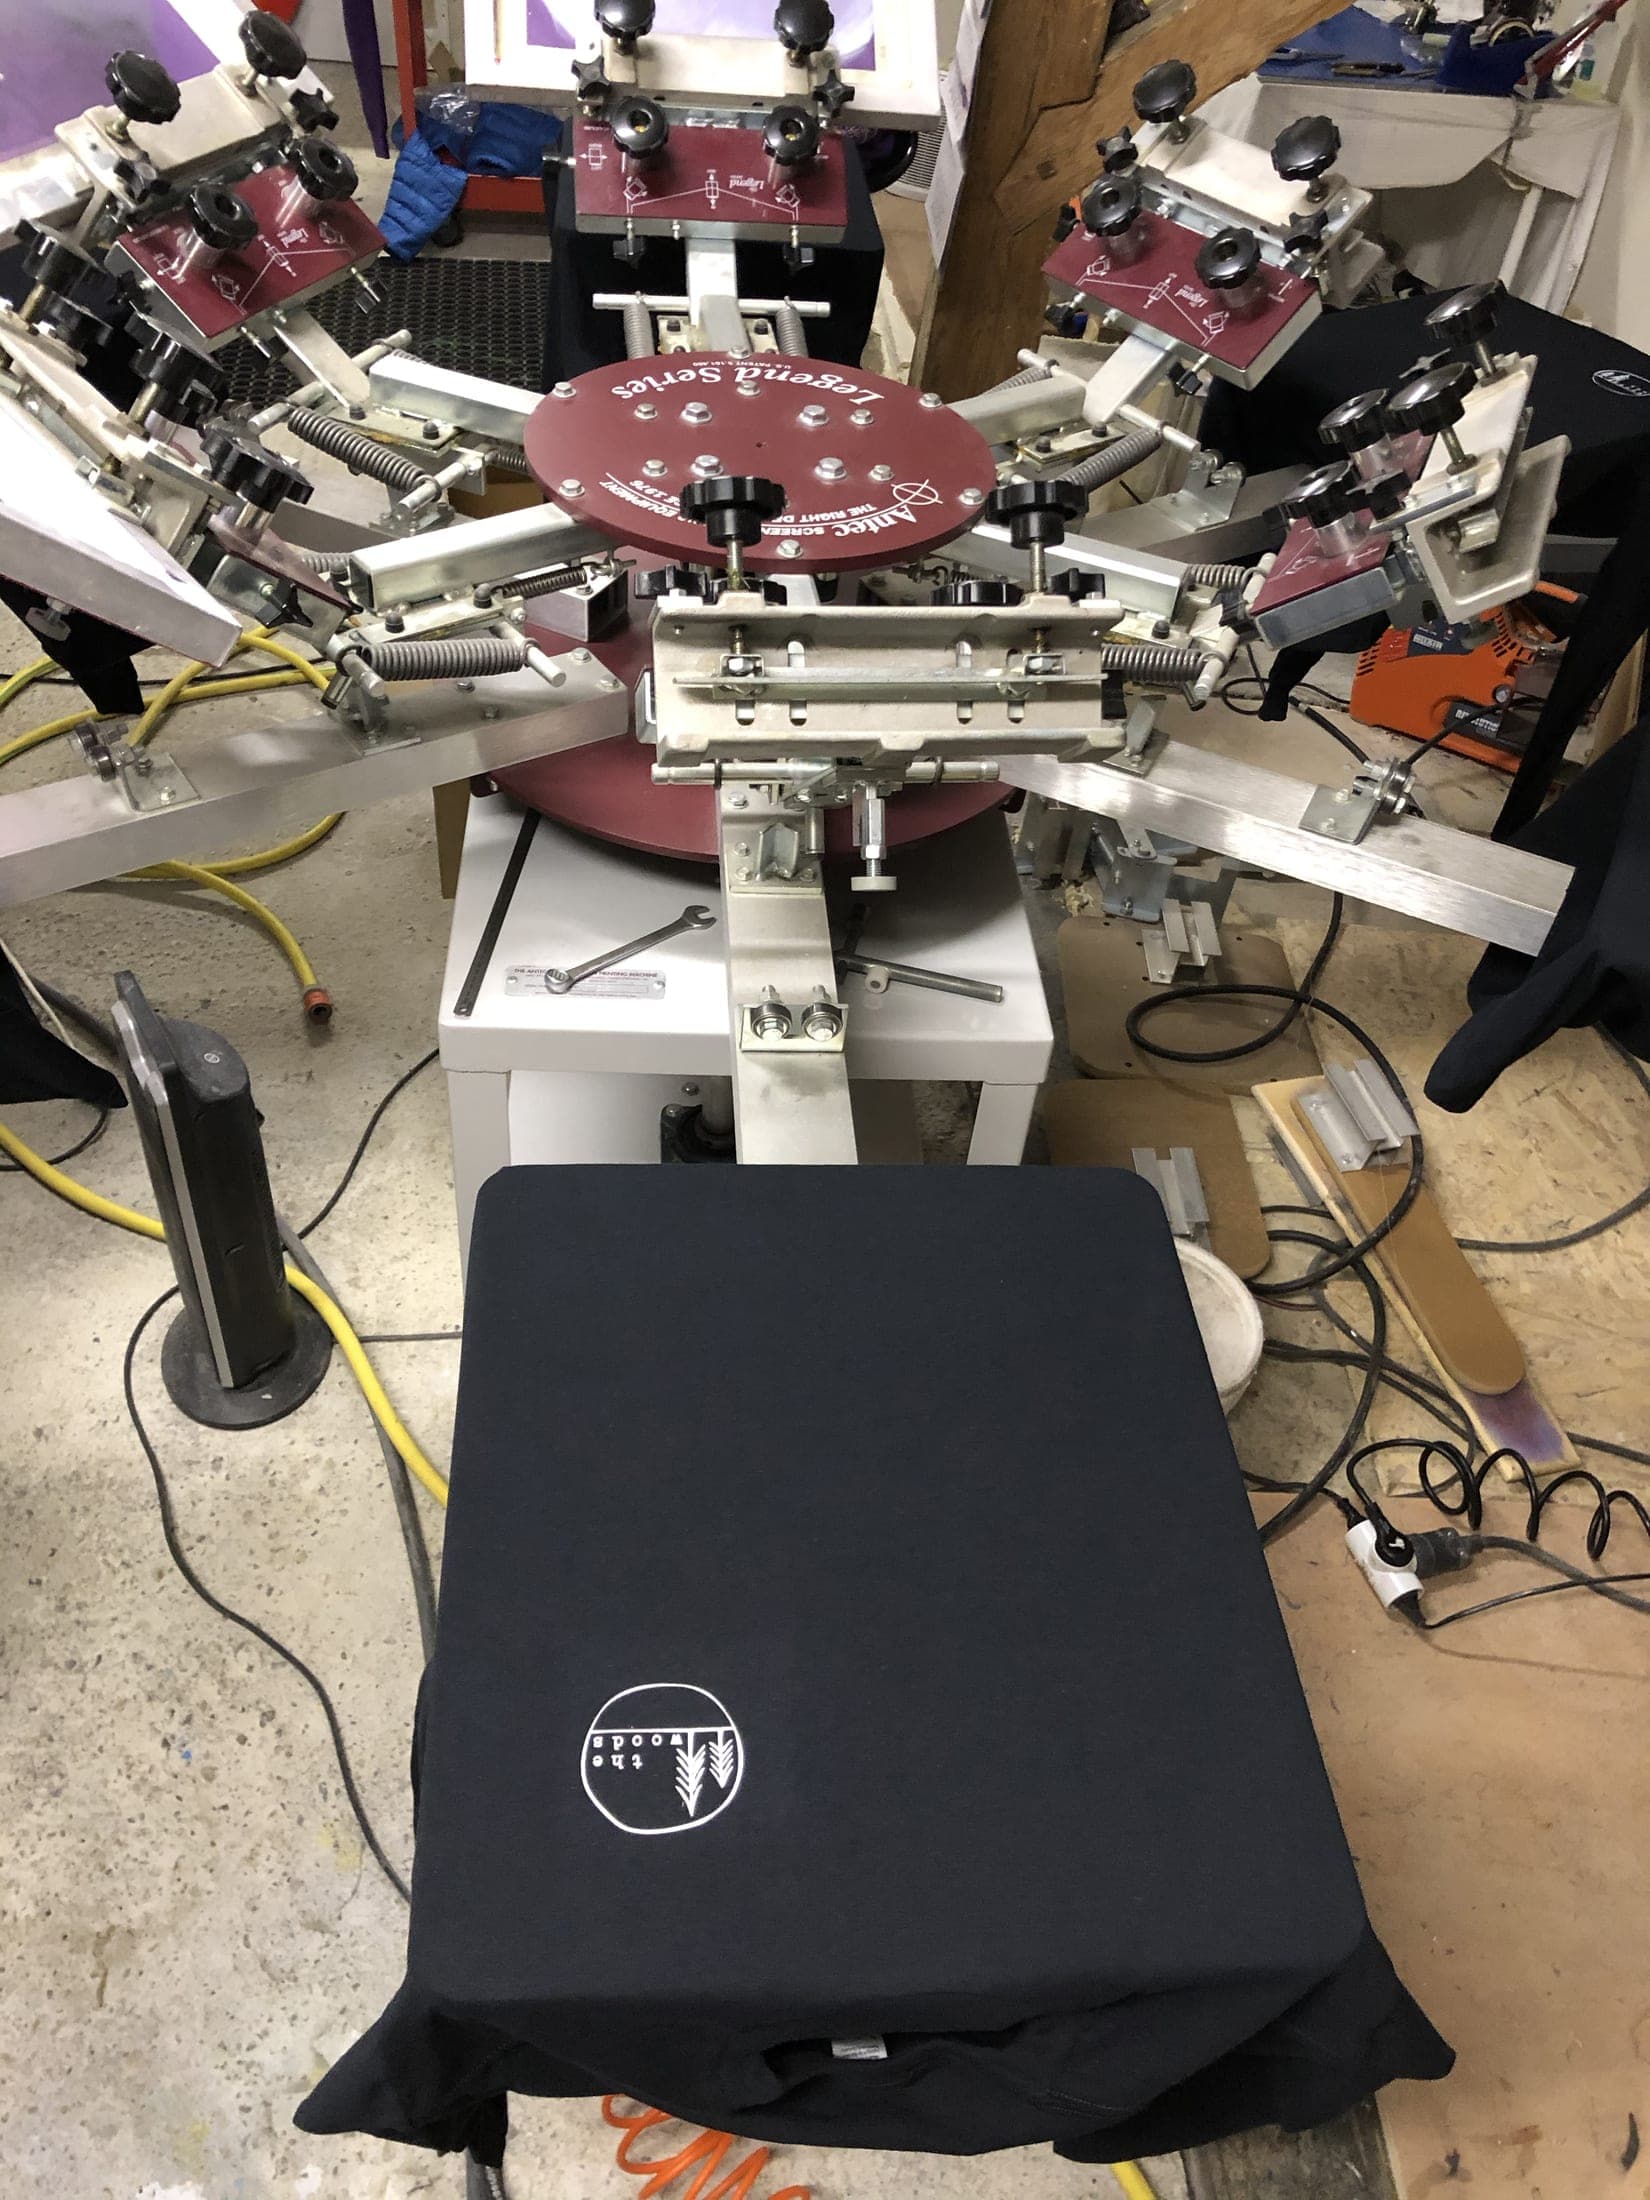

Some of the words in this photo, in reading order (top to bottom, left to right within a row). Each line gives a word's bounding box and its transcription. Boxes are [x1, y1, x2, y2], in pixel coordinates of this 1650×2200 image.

[611, 367, 722, 399] Series
[734, 367, 885, 405] Legend
[599, 481, 678, 518] EQUIPMENT
[629, 480, 667, 501] 1976
[800, 511, 846, 523] RIGHT
[847, 503, 877, 517] THE
[832, 505, 917, 537] Antec
[592, 1734, 684, 1751] woods
[592, 1754, 643, 1770] the
